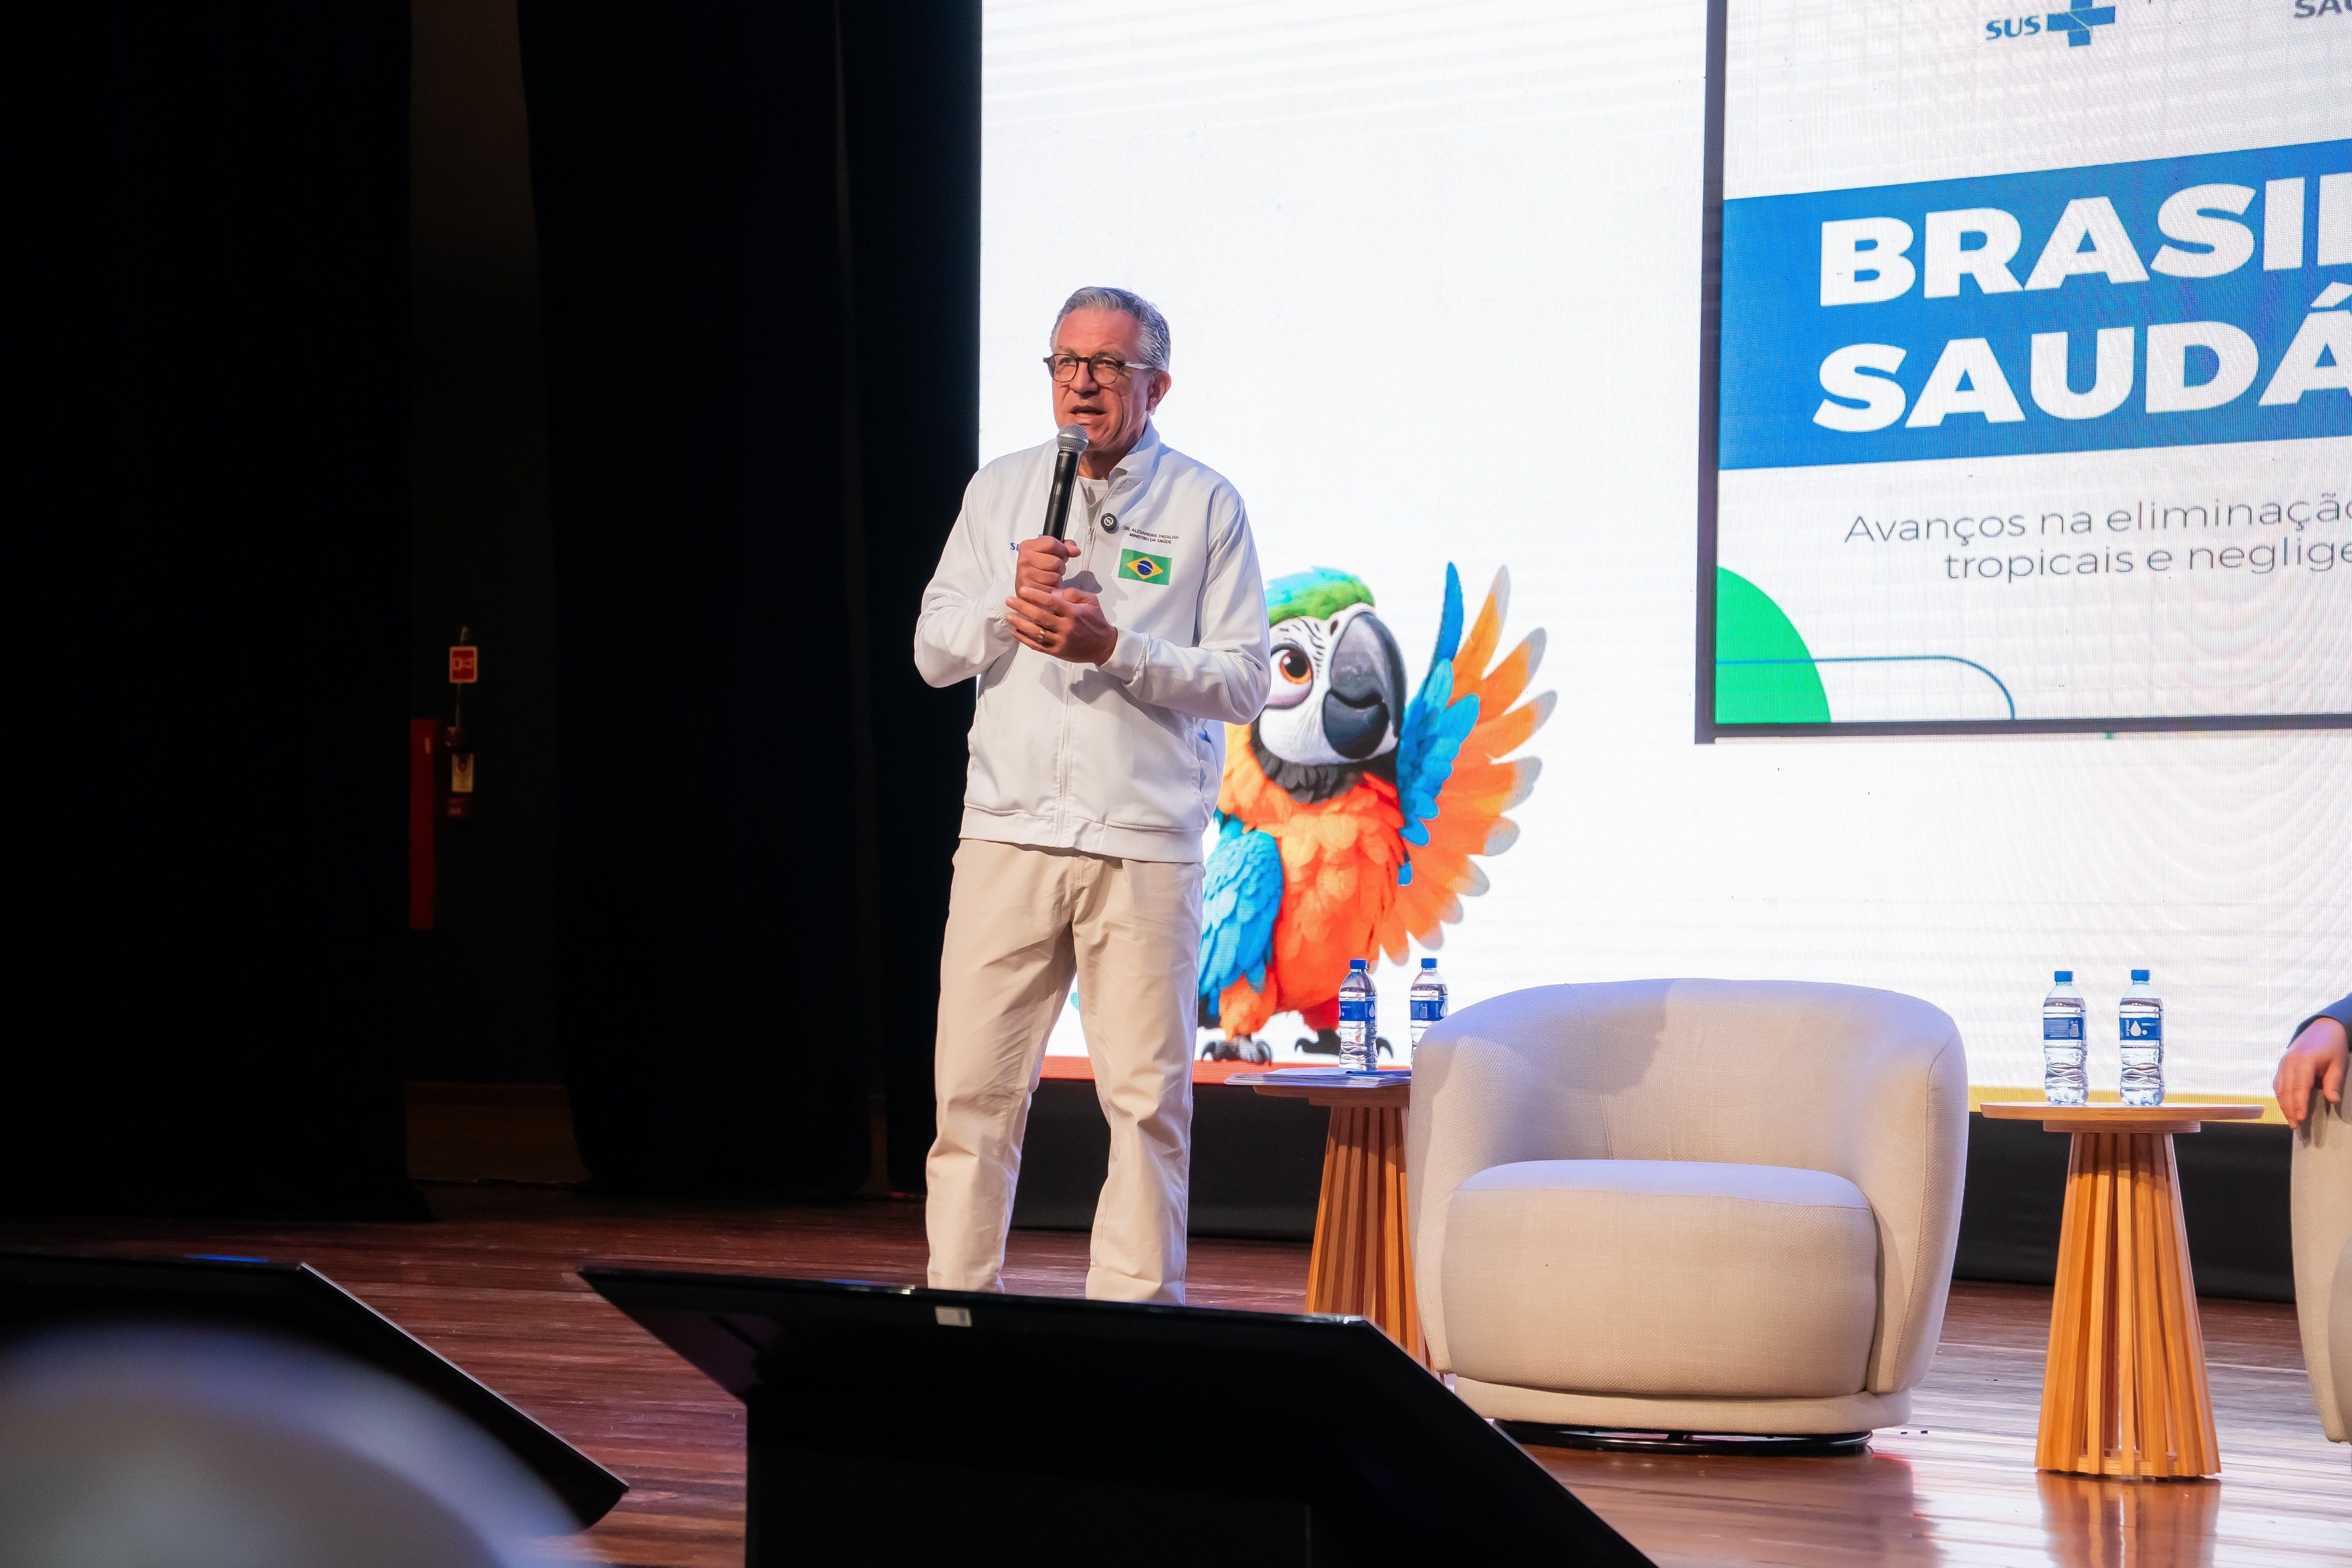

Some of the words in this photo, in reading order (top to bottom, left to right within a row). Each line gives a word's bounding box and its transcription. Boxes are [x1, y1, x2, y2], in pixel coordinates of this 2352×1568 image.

[1986, 15, 2041, 40] SUS
[1844, 515, 2027, 546] Avanços
[2040, 511, 2092, 535] na
[2107, 492, 2352, 532] eliminaçã
[1129, 532, 1149, 541] MINISTRO
[1131, 528, 1158, 538] ALEXANDRE
[1944, 546, 2134, 584] tropicais
[2147, 549, 2172, 571] e
